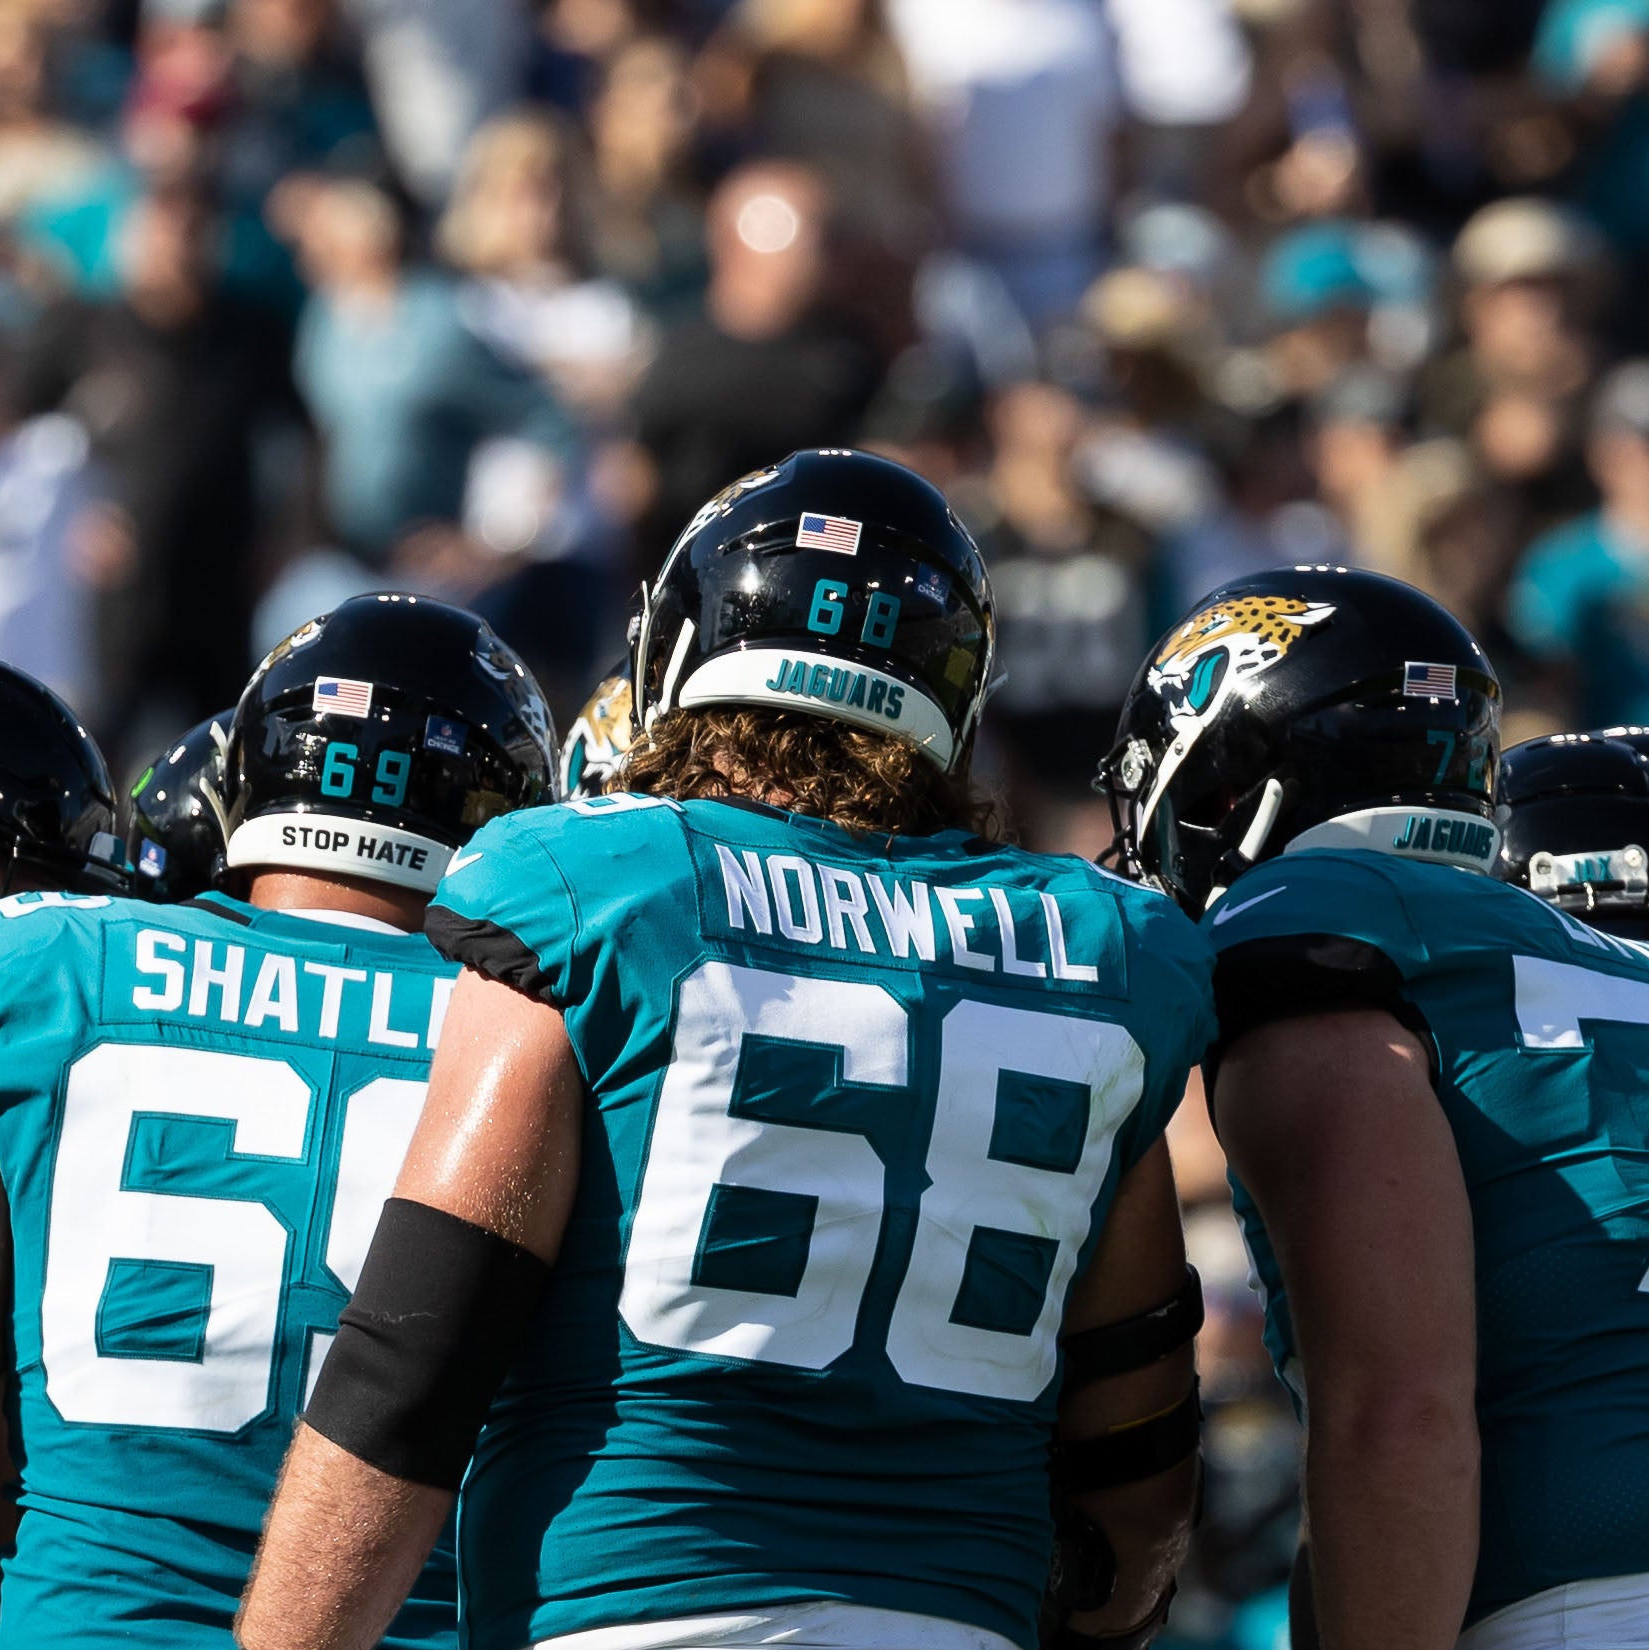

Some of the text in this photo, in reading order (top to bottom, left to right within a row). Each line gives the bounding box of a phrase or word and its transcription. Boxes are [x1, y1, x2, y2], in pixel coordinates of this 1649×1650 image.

[807, 578, 901, 648] 68
[767, 658, 905, 719] JAGUARS
[320, 741, 412, 808] 69
[282, 825, 429, 871] STOP HATE
[1567, 856, 1613, 884] JAX
[714, 844, 1099, 983] NORWELL
[618, 961, 1146, 1402] 68
